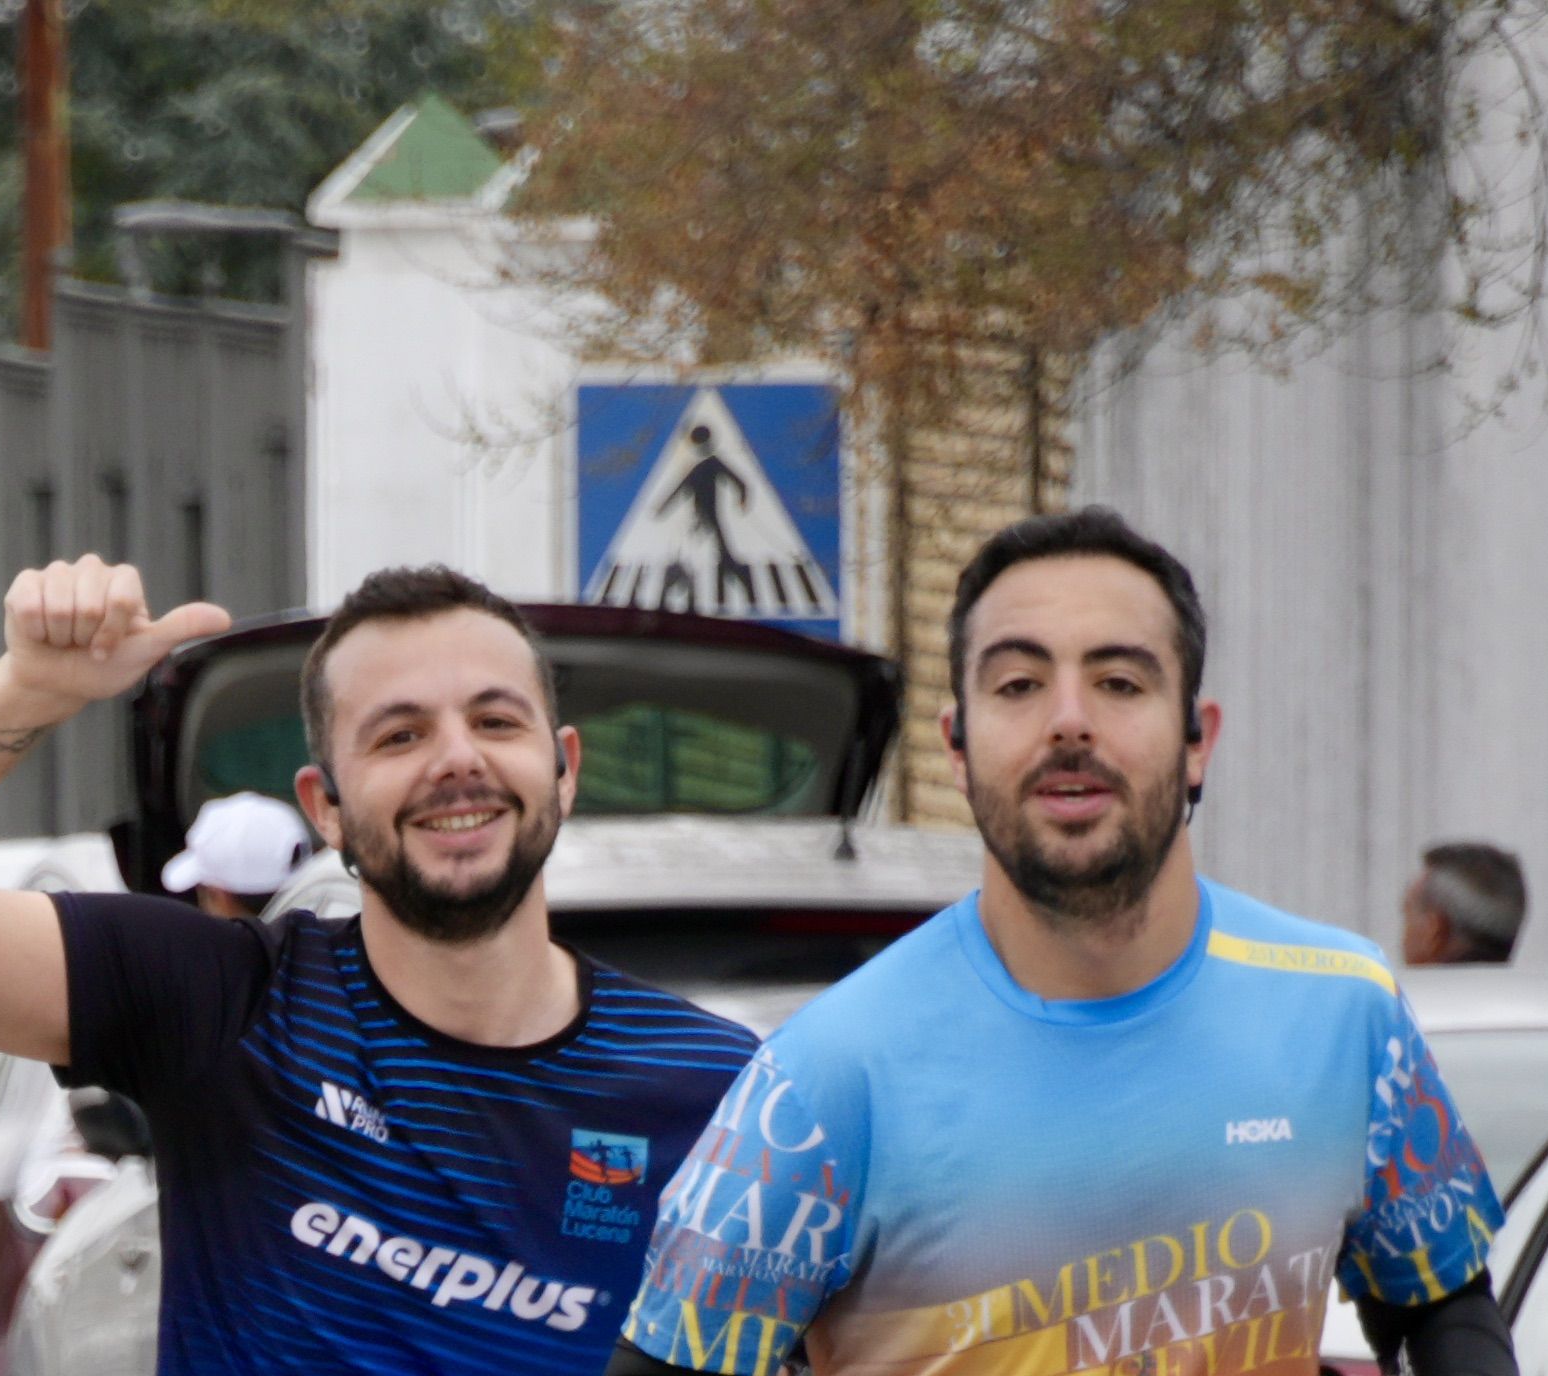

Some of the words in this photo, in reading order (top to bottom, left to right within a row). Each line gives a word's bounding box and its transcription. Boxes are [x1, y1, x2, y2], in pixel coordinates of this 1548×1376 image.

[351, 1114, 389, 1145] PRO
[1226, 1117, 1292, 1145] HOKA
[290, 1201, 595, 1332] enerplus
[1015, 1208, 1273, 1332] MEDIO
